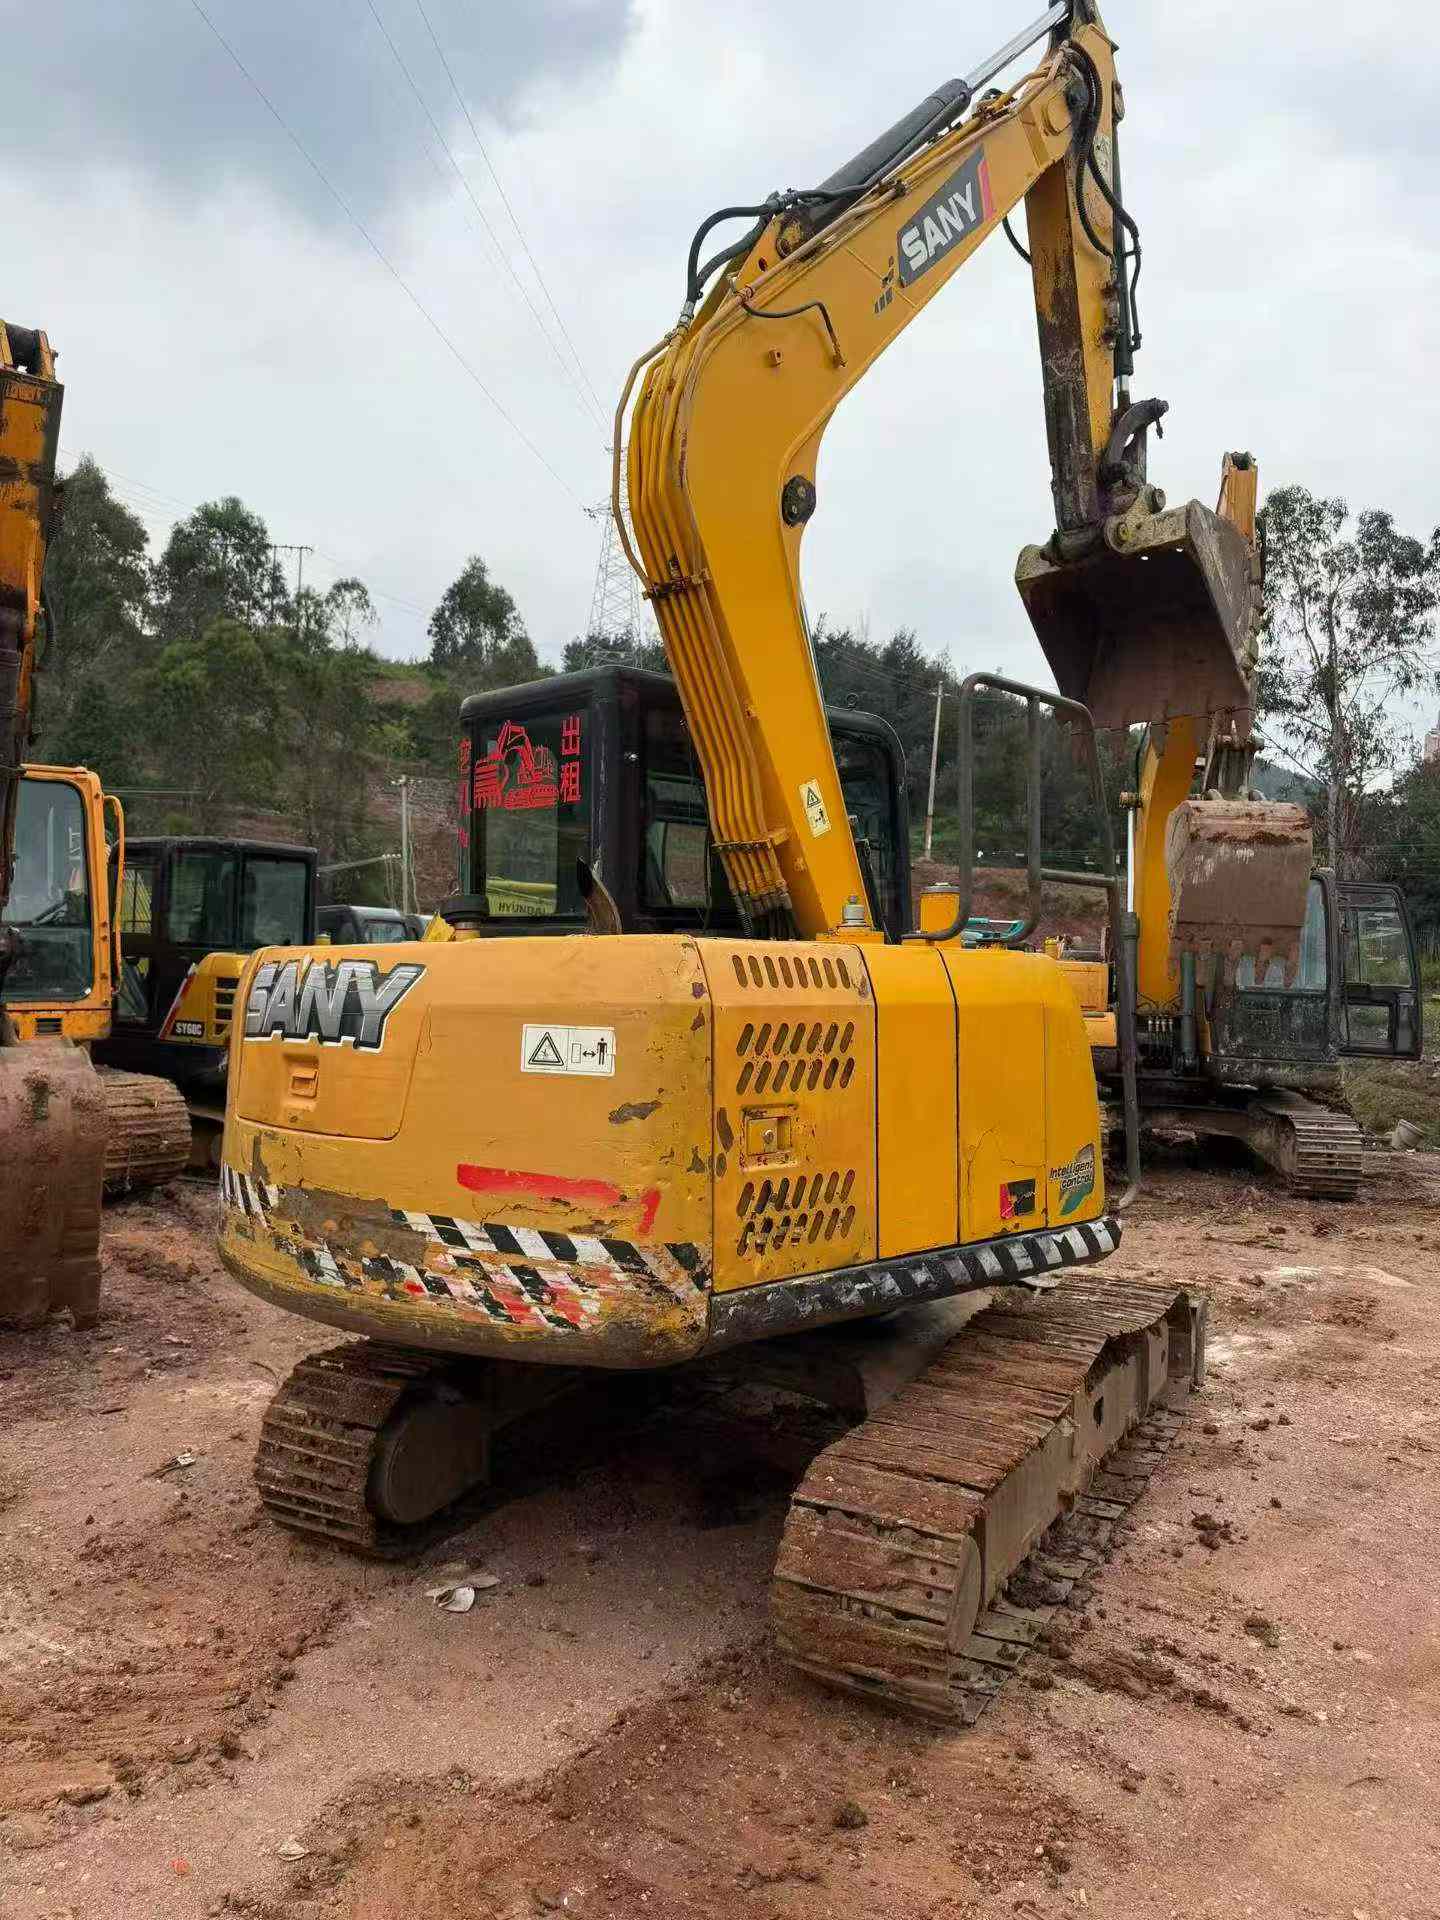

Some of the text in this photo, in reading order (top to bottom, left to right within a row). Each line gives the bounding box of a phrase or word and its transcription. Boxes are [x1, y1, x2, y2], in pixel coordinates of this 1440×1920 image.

[902, 181, 976, 271] SANY
[560, 715, 582, 803] 出租
[498, 901, 546, 915] HYUNDAI
[245, 960, 426, 1050] SANY
[1049, 1160, 1094, 1180] Intelligent
[1061, 1173, 1093, 1189] control
